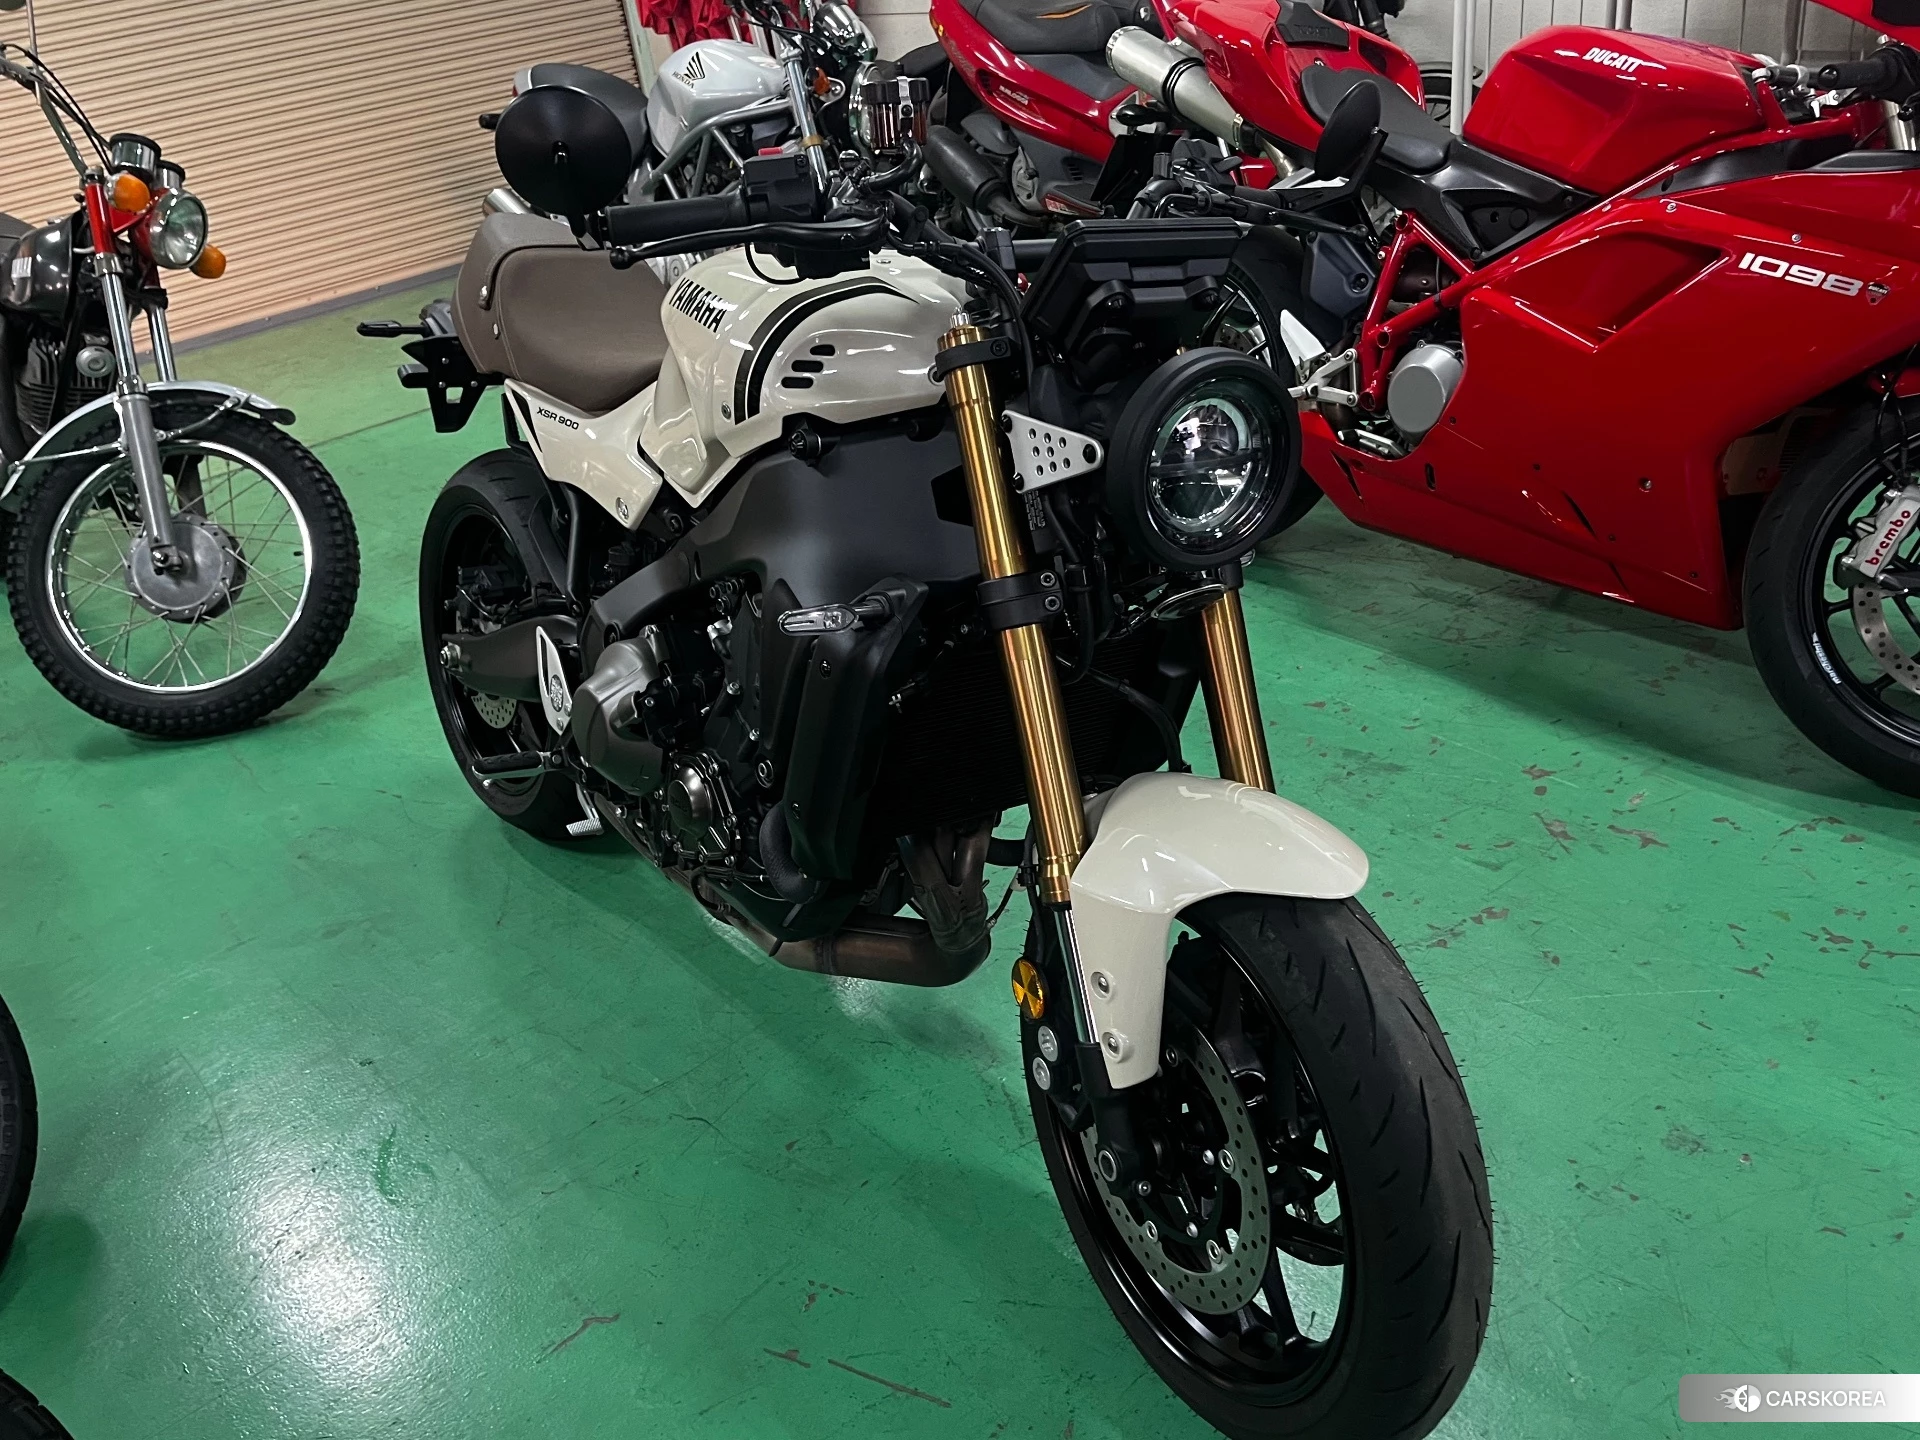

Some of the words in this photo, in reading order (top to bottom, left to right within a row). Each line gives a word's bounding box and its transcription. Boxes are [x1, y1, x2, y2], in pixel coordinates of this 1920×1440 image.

[1582, 46, 1643, 73] DUCATI
[672, 71, 695, 89] HONDA
[1738, 252, 1864, 297] 1098
[669, 277, 728, 333] YAMAHA
[536, 406, 558, 422] XSR
[557, 415, 580, 430] 900
[1865, 510, 1911, 566] brembo
